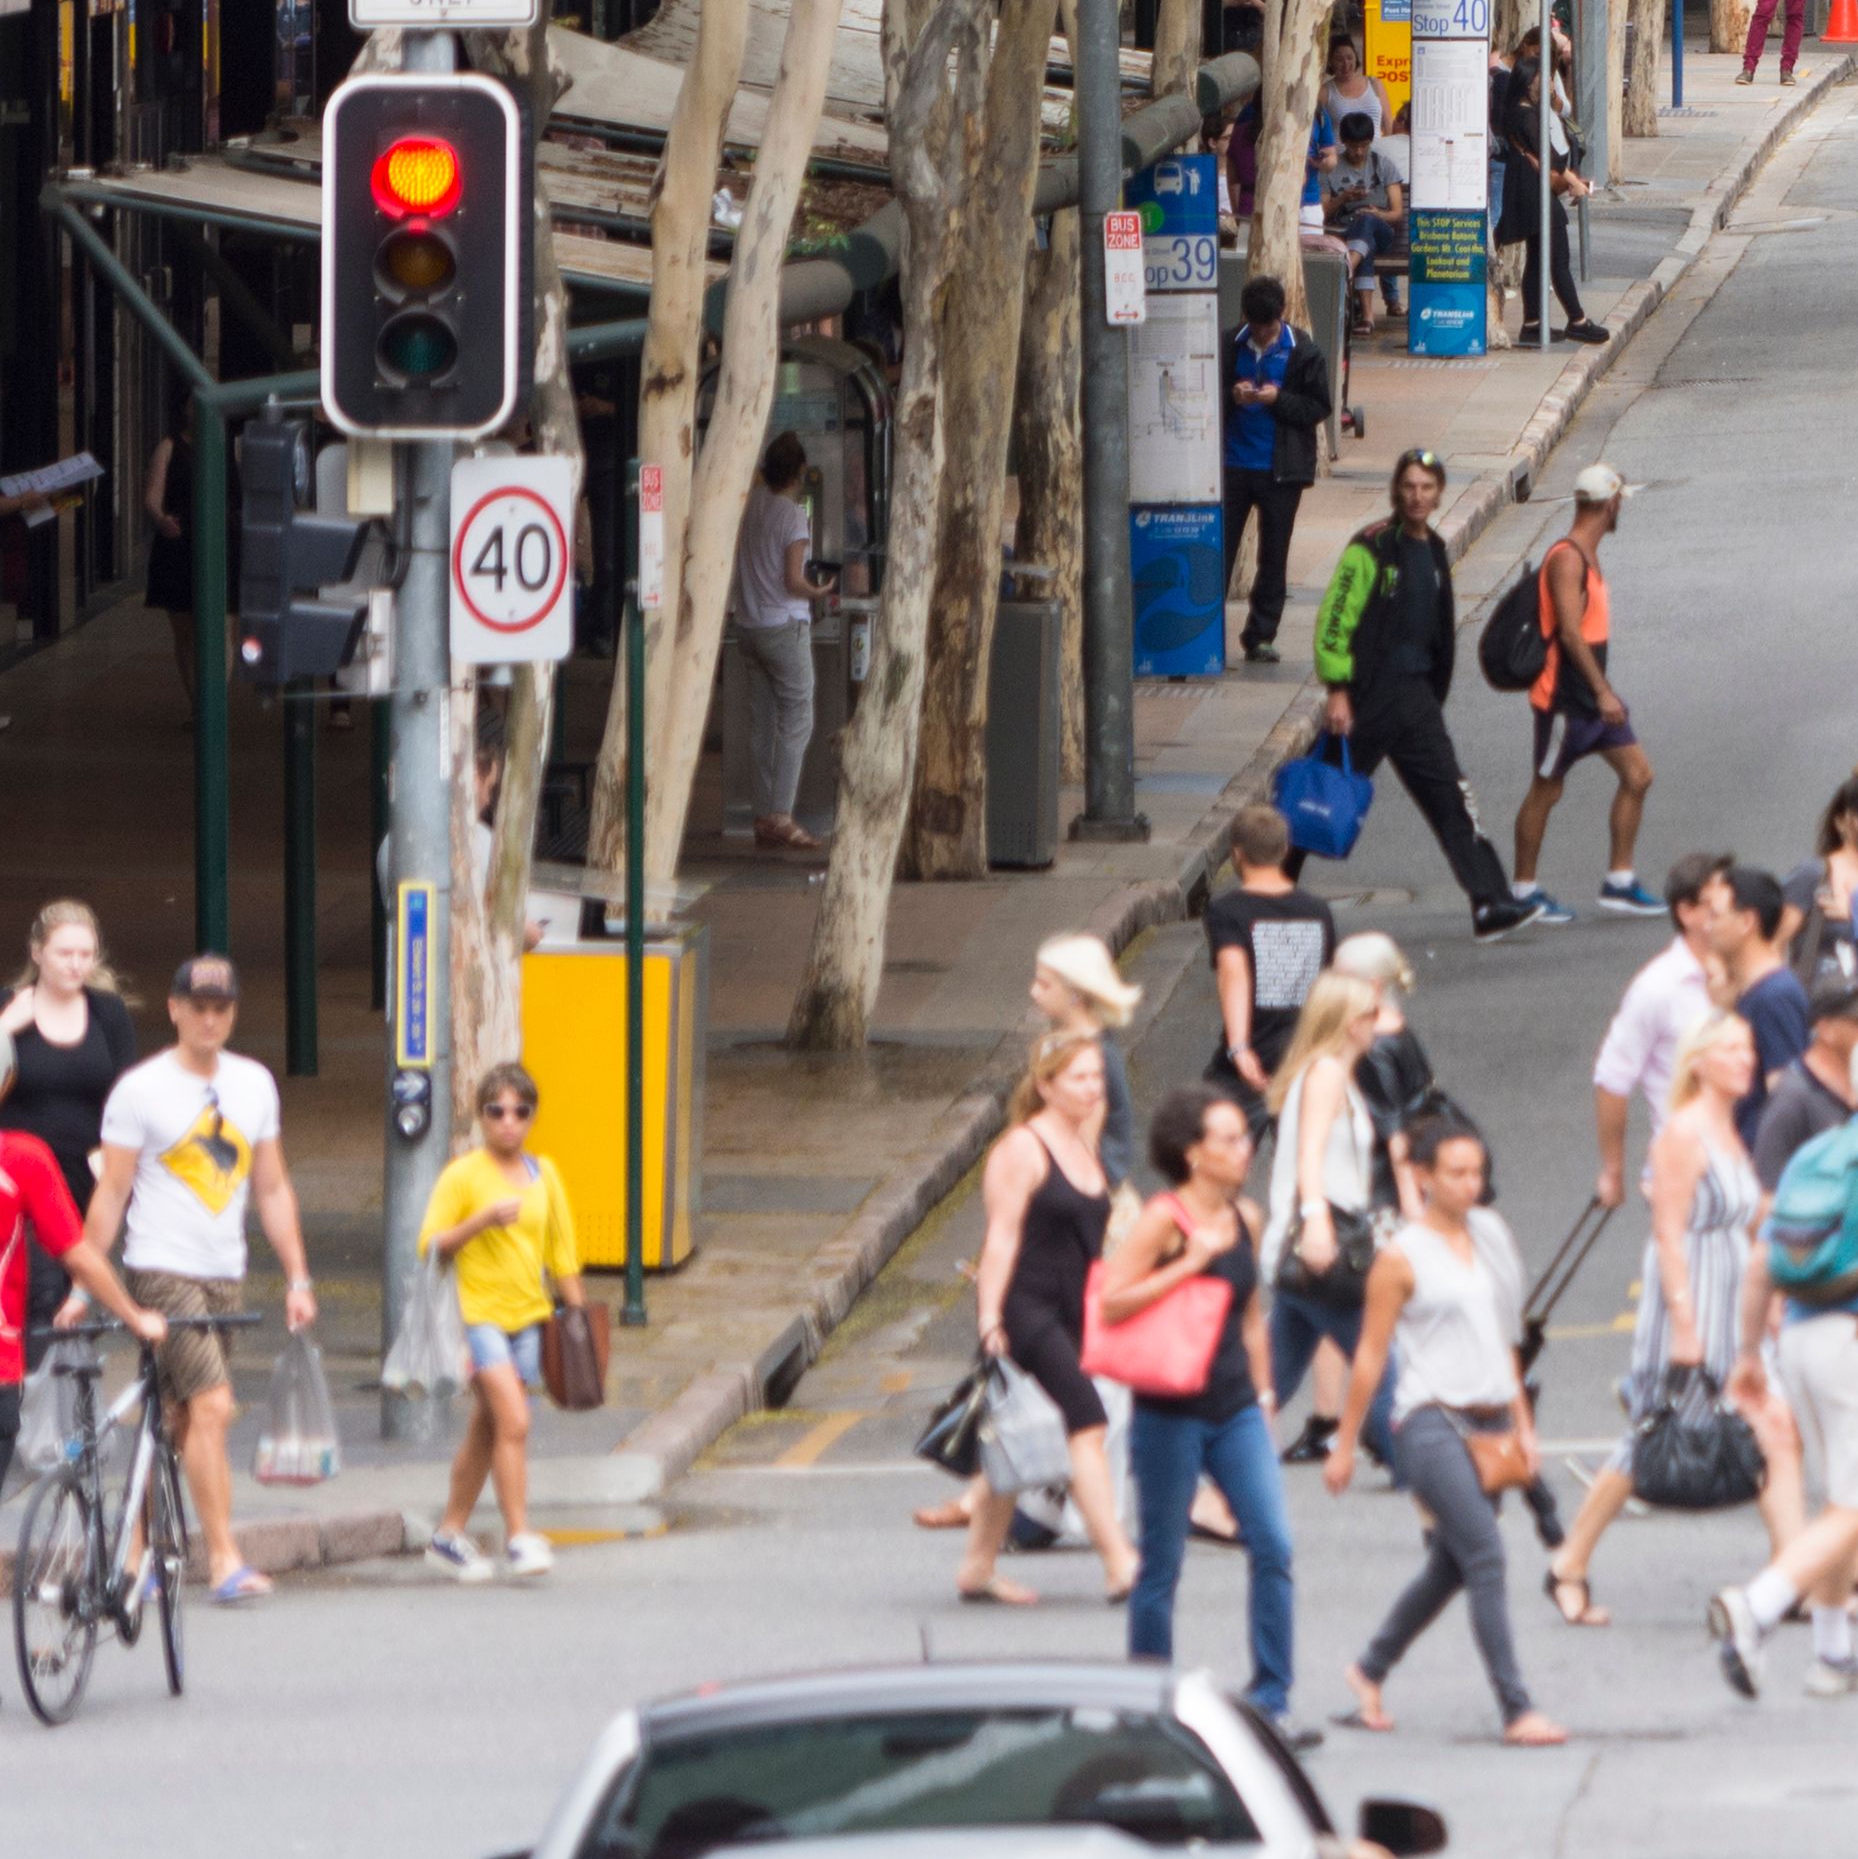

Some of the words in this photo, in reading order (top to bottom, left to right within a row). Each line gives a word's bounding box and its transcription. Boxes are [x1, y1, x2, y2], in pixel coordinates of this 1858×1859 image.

[1414, 14, 1449, 35] Stop
[1376, 55, 1412, 68] Expr
[1110, 218, 1134, 232] BUS
[1107, 233, 1138, 248] ZONE
[1144, 266, 1169, 286] op
[1171, 237, 1216, 282] 39
[643, 471, 661, 488] BUS
[642, 493, 662, 511] ZONE
[469, 522, 551, 593] 40
